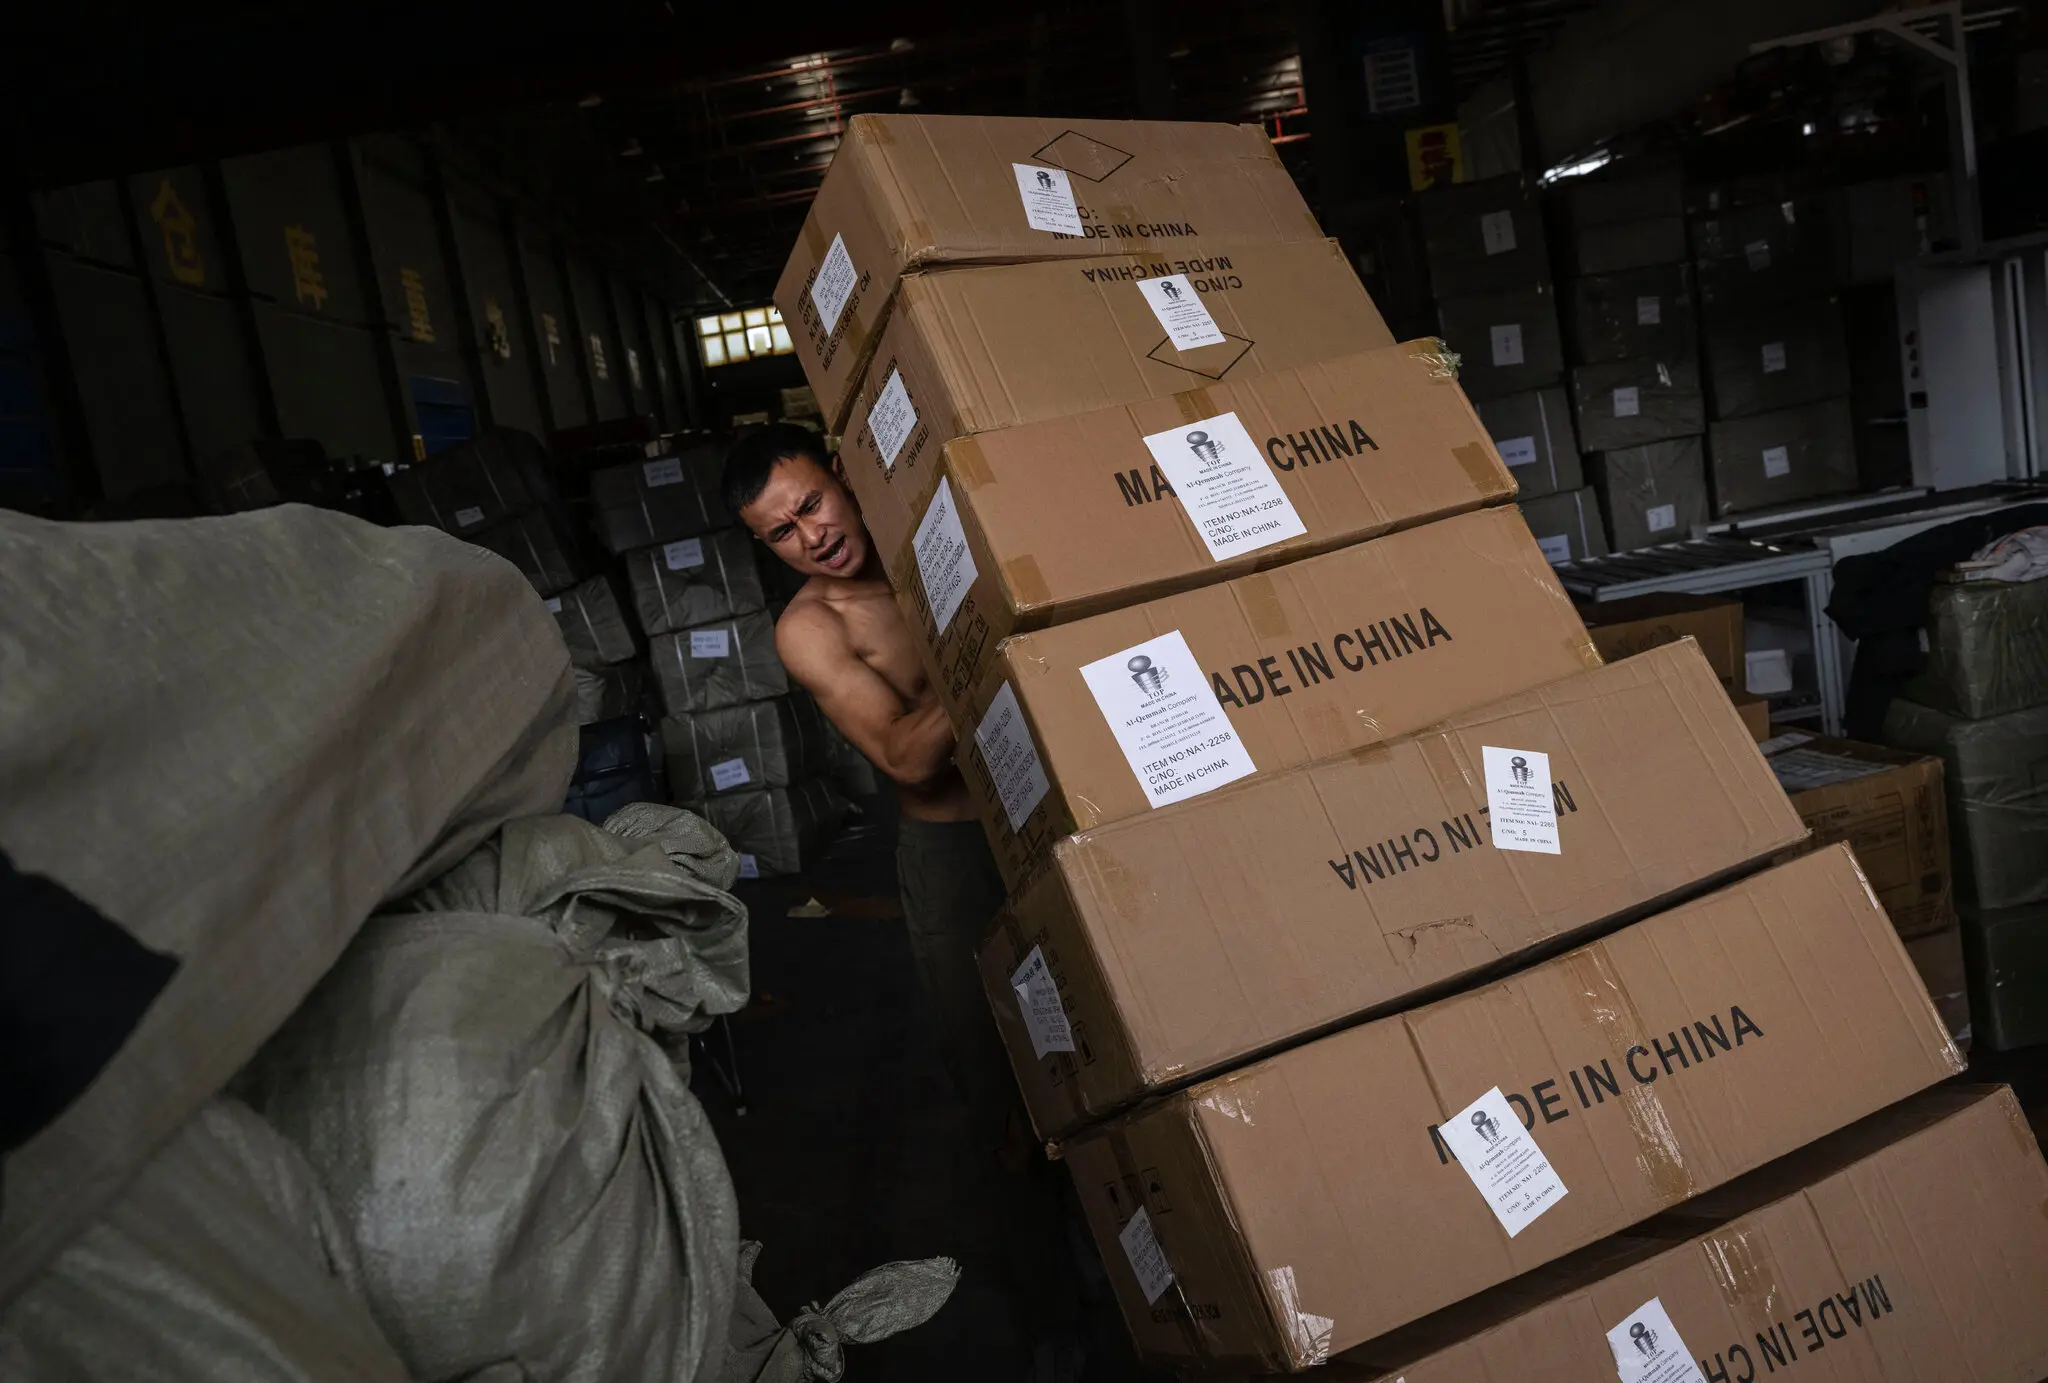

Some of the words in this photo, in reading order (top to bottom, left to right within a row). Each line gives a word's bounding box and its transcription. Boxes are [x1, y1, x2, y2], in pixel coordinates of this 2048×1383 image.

[1115, 224, 1134, 239] IN
[1137, 222, 1198, 238] CHINA
[1081, 265, 1147, 283] CHINA
[1153, 261, 1174, 277] IN
[1174, 256, 1233, 275] MADE
[1113, 464, 1177, 507] MA
[1266, 420, 1380, 472] CHINA
[1206, 457, 1221, 467] TOP
[1217, 461, 1232, 469] CHINA
[1223, 465, 1251, 477] Company
[1202, 515, 1226, 529] ITEM
[1208, 524, 1235, 538] C/NO:
[1213, 532, 1241, 547] MADE
[1240, 528, 1252, 538] IN
[1251, 520, 1281, 534] CHINA
[1211, 654, 1292, 711] ADE
[1286, 641, 1335, 688] IN
[1333, 607, 1452, 673] CHINA
[1140, 699, 1155, 709] MADE
[1160, 691, 1177, 701] CHINA
[1148, 688, 1164, 699] TOP
[1126, 706, 1167, 727] Al-Qemmah
[1167, 694, 1197, 710] Company
[1142, 758, 1169, 774] ITEM
[1168, 732, 1231, 763] NO:NA1-2258
[1148, 768, 1178, 785] C/NO:
[1153, 777, 1184, 796] MADE
[1183, 771, 1197, 783] IN
[1196, 758, 1229, 777] CHINA
[1441, 813, 1483, 854] IN
[1328, 828, 1440, 890] CHINA
[1569, 1058, 1622, 1109] IN
[1626, 1005, 1765, 1085] CHINA
[1498, 1189, 1513, 1202] ITEM
[1522, 1200, 1535, 1212] MADE
[1540, 1184, 1555, 1197] CHINA
[1524, 1192, 1531, 1200] 5
[1794, 1274, 1894, 1353] MADE
[1755, 1321, 1798, 1373] IN
